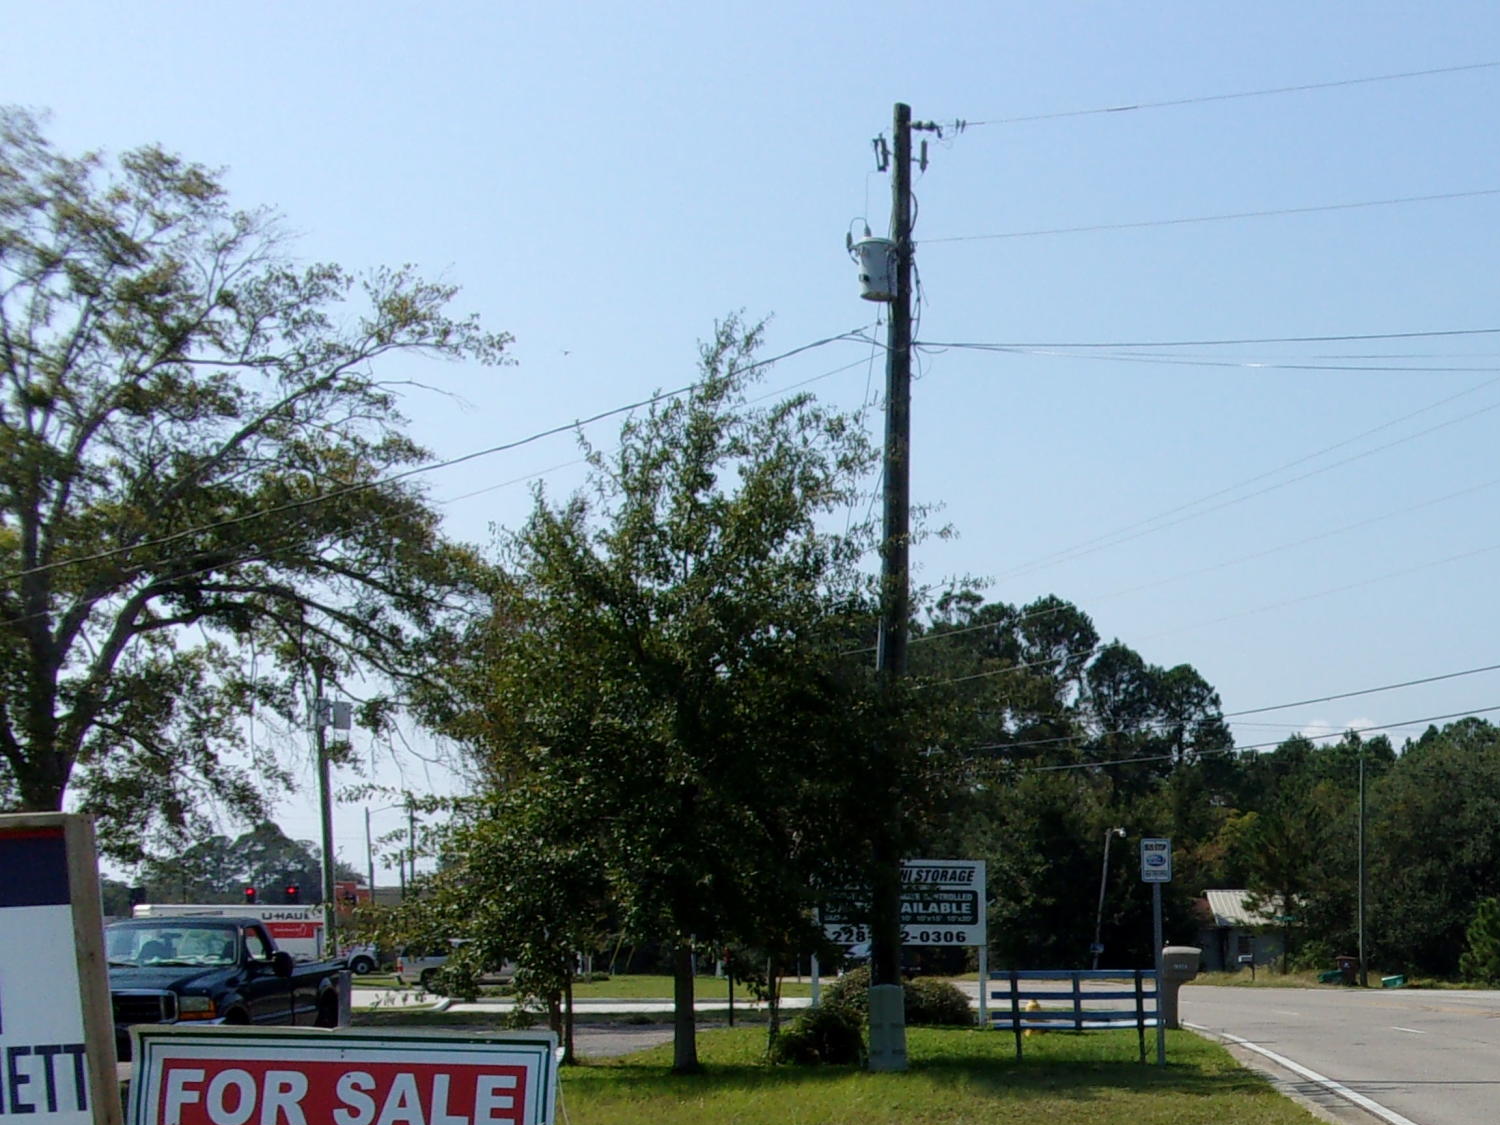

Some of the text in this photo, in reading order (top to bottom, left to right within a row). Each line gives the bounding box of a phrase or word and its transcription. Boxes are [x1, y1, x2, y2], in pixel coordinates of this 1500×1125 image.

[915, 869, 975, 882] STORAGE
[900, 902, 972, 914] AILABLE
[0, 1043, 88, 1115] ETT
